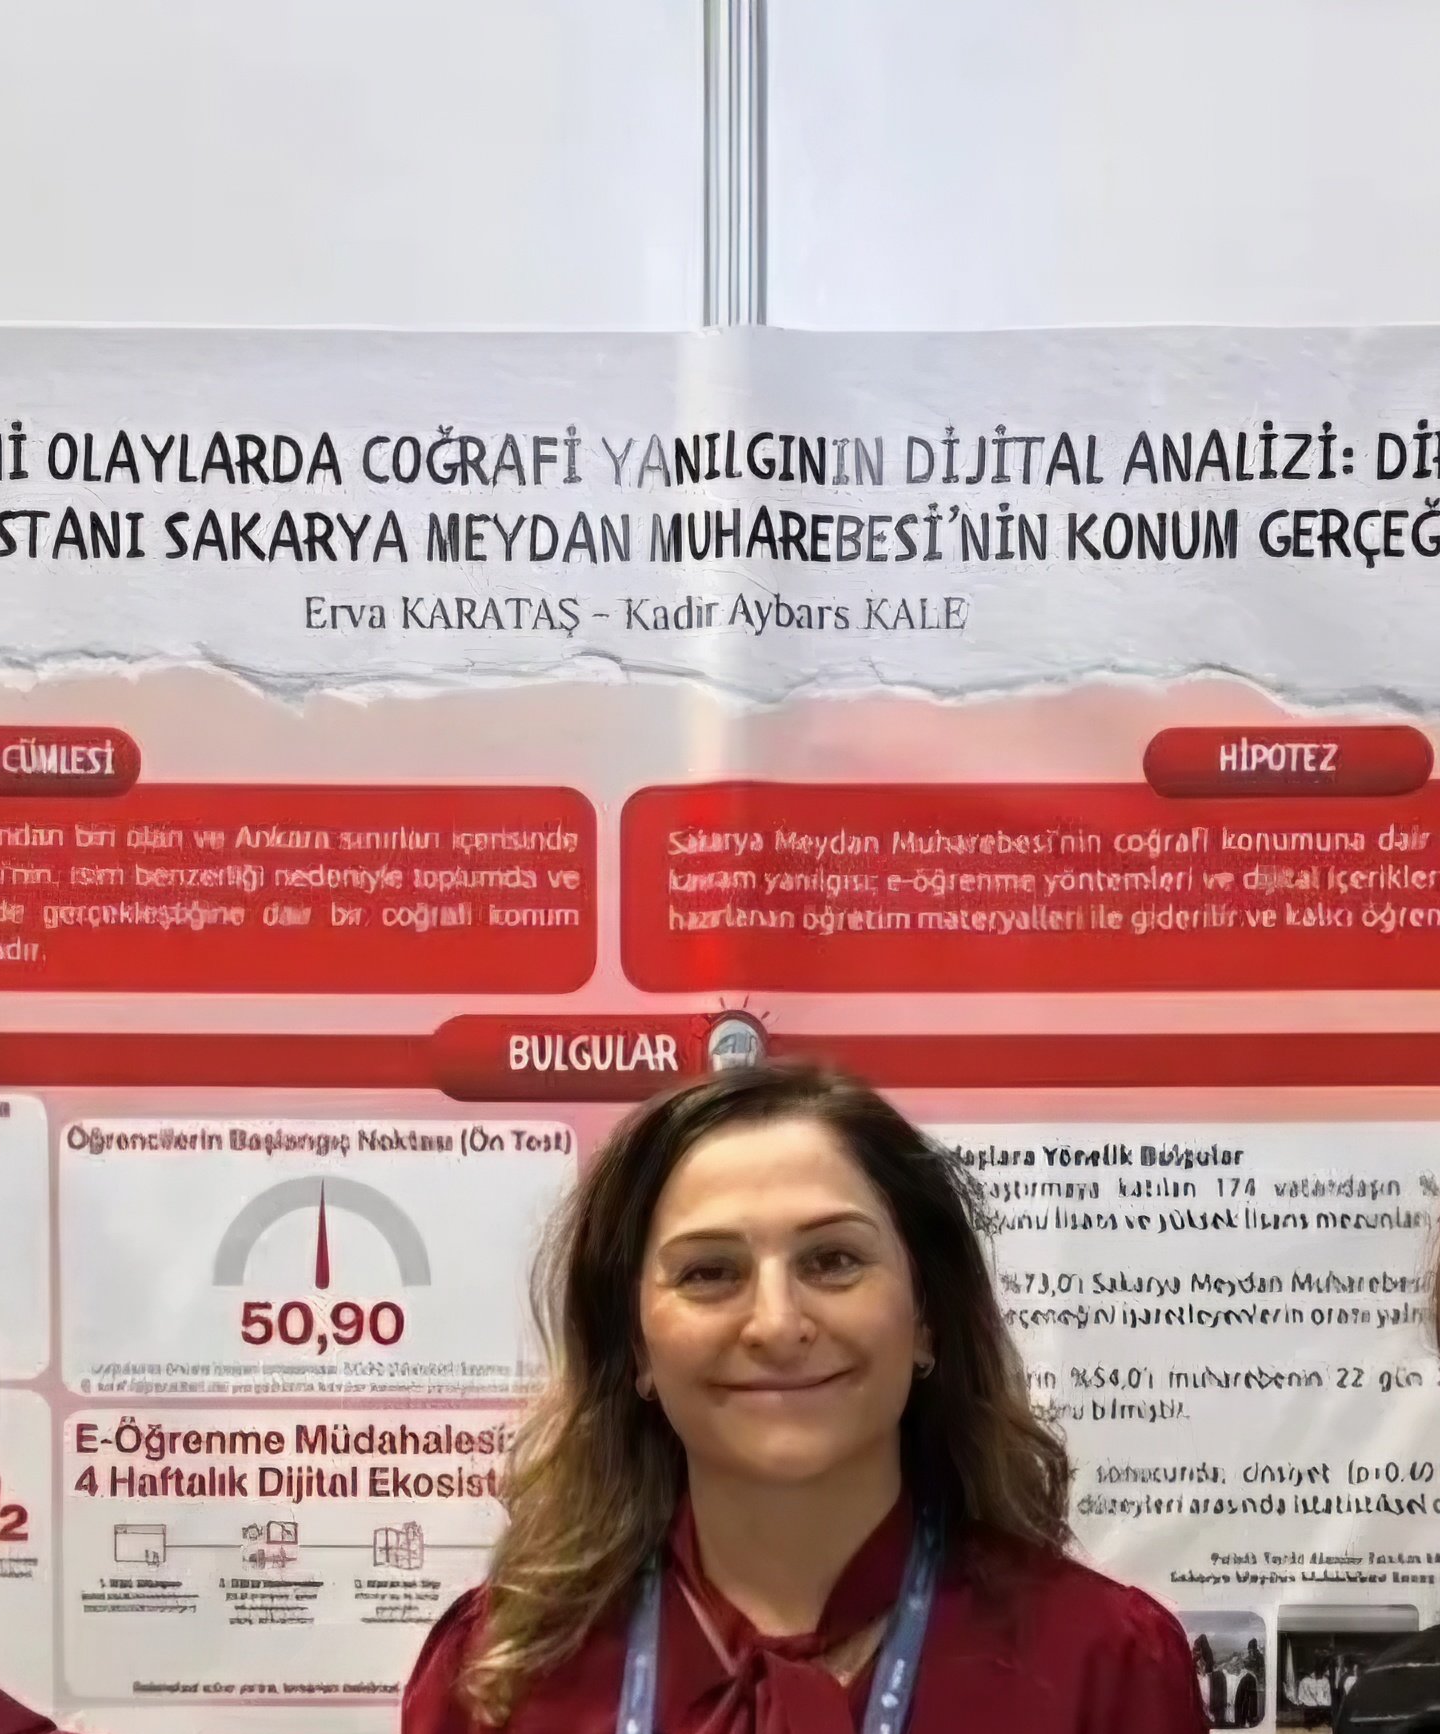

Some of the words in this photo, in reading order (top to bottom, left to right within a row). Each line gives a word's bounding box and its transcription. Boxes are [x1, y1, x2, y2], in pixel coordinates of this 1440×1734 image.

[47, 430, 343, 485] OLAYLARDA
[362, 423, 583, 486] COĞRAFİ
[601, 429, 885, 487] YANILGININ
[904, 423, 1104, 487] DİJİTAL
[1124, 419, 1355, 485] ANALİZİ:
[165, 509, 408, 562] SAKARYA
[427, 511, 630, 563] MEYDAN
[1068, 511, 1239, 561] KONUM
[305, 596, 387, 630] Erva
[402, 595, 580, 637] KARATAŞ
[727, 592, 851, 636] Aybars
[863, 595, 966, 631] KALE
[1, 737, 116, 775] CÜMLESİ
[1218, 733, 1339, 773] HİPOTEZ
[509, 1033, 679, 1072] BULGULAR
[240, 1300, 405, 1356] 50,90
[74, 1416, 286, 1462] E-Öğrenme
[73, 1468, 99, 1498] 4
[109, 1465, 249, 1498] Haftalık
[258, 1466, 359, 1505] Dijital
